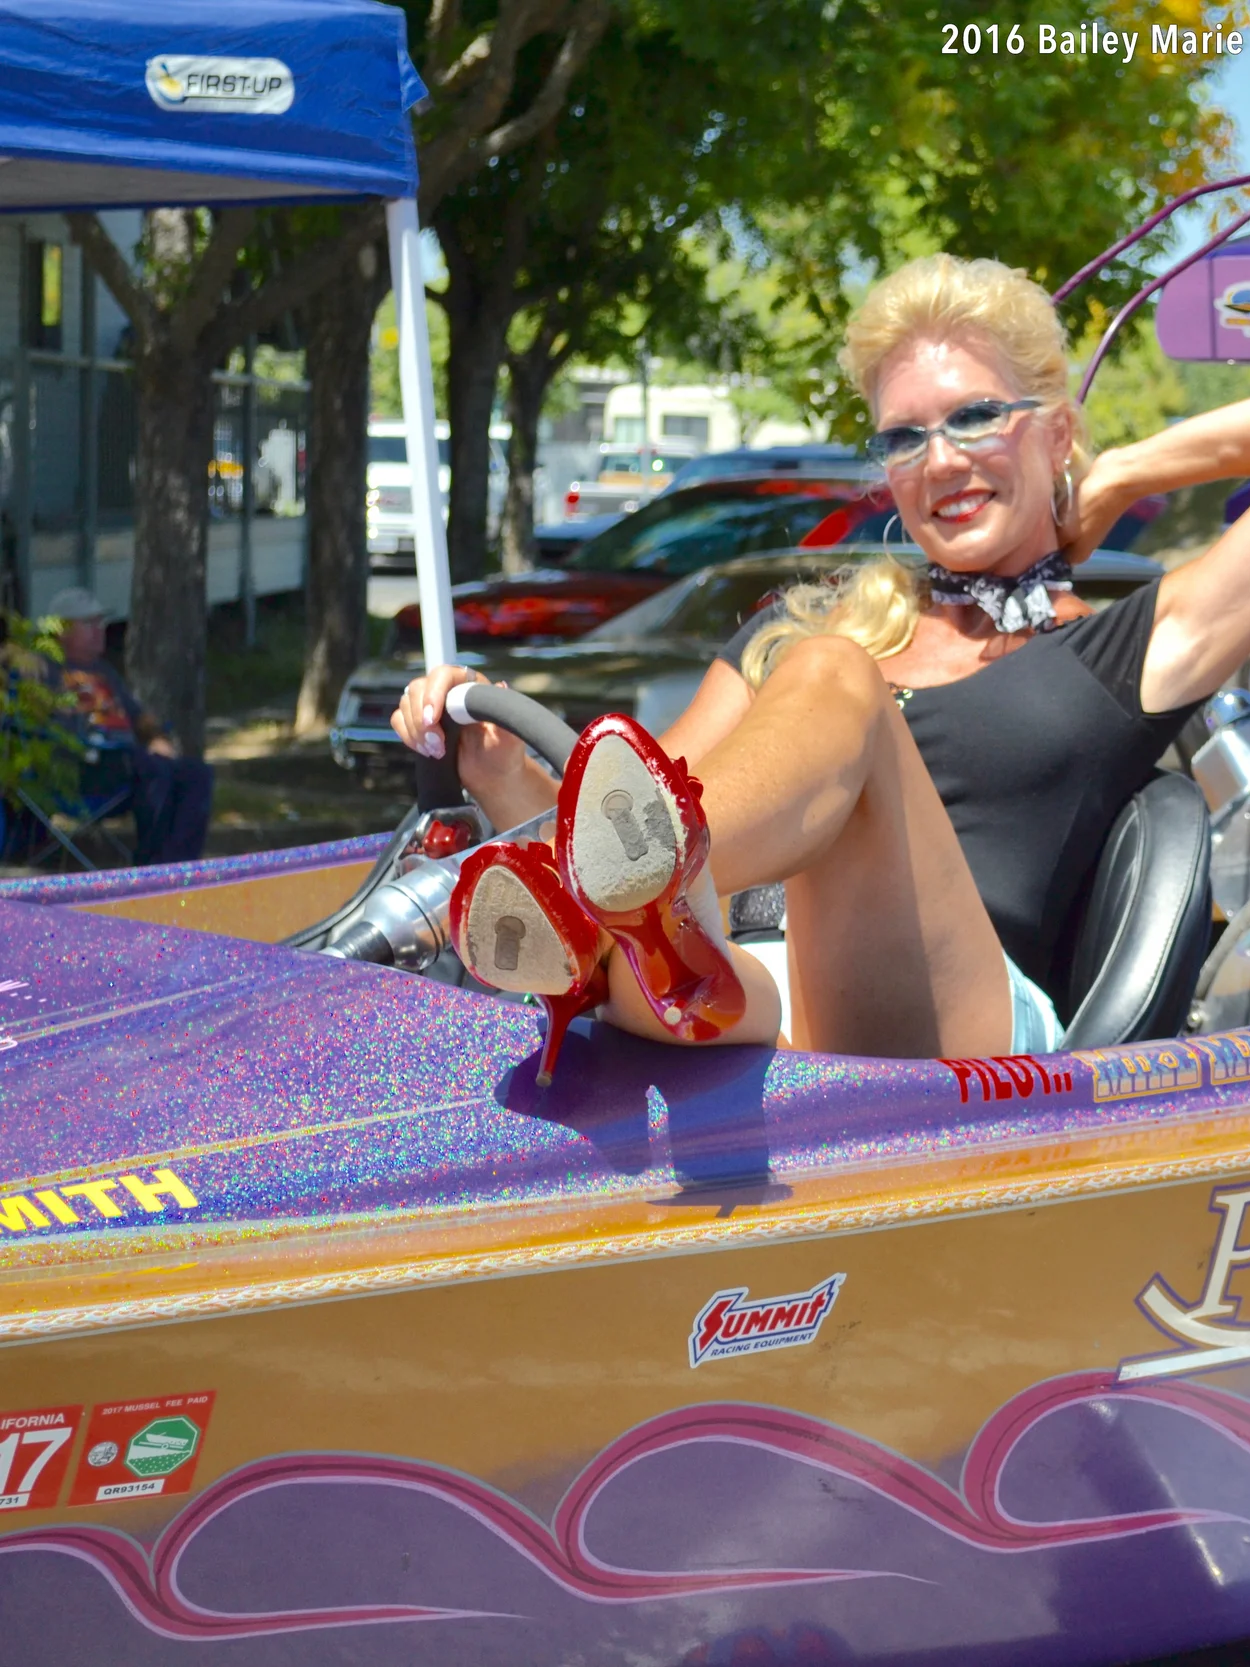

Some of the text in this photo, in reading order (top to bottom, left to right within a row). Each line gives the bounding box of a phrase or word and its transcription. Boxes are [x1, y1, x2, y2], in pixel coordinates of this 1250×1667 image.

[711, 1332, 814, 1357] RACING EQUIPMENT
[102, 1395, 208, 1415] 2017 MUSSEL FEE PAID
[0, 1412, 65, 1430] IFORNIA
[0, 1427, 72, 1494] 17
[104, 1482, 155, 1496] QR93154
